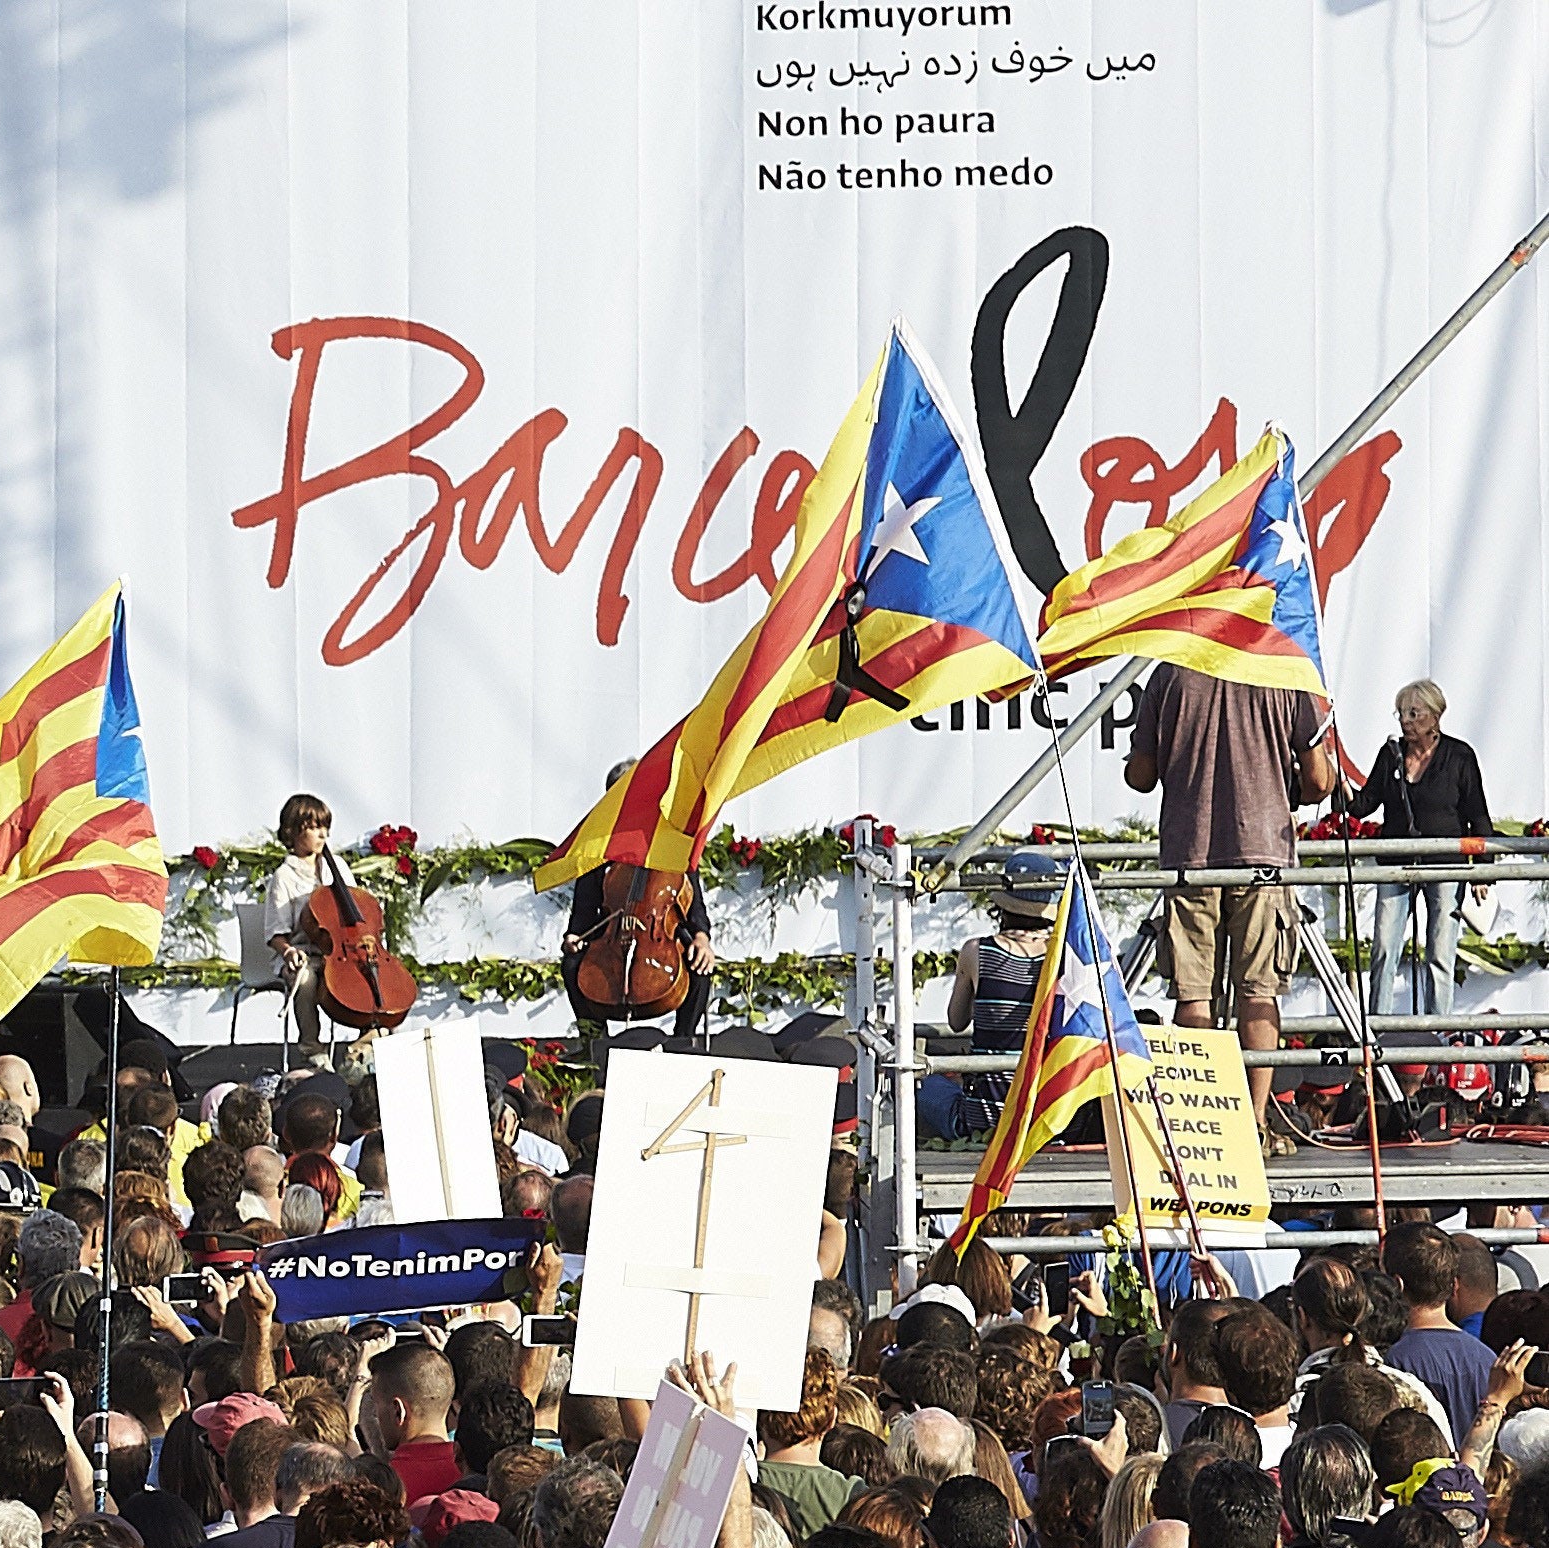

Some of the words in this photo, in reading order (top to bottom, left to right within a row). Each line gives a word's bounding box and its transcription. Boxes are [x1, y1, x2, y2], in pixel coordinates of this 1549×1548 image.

[756, 1, 1012, 36] Korkmuyorum
[991, 41, 1073, 82] خوف
[1085, 52, 1156, 81] میں
[757, 111, 828, 137] Non
[840, 107, 883, 135] ho
[896, 111, 995, 142] paura
[757, 161, 826, 190] Não
[837, 159, 943, 189] tenho
[955, 157, 1054, 186] medo
[1152, 1065, 1217, 1083] EOPLE
[1180, 1093, 1241, 1111] WANT
[1159, 1169, 1213, 1188] DAL
[1217, 1174, 1238, 1189] IN
[267, 1248, 525, 1279] #NoTenimPor
